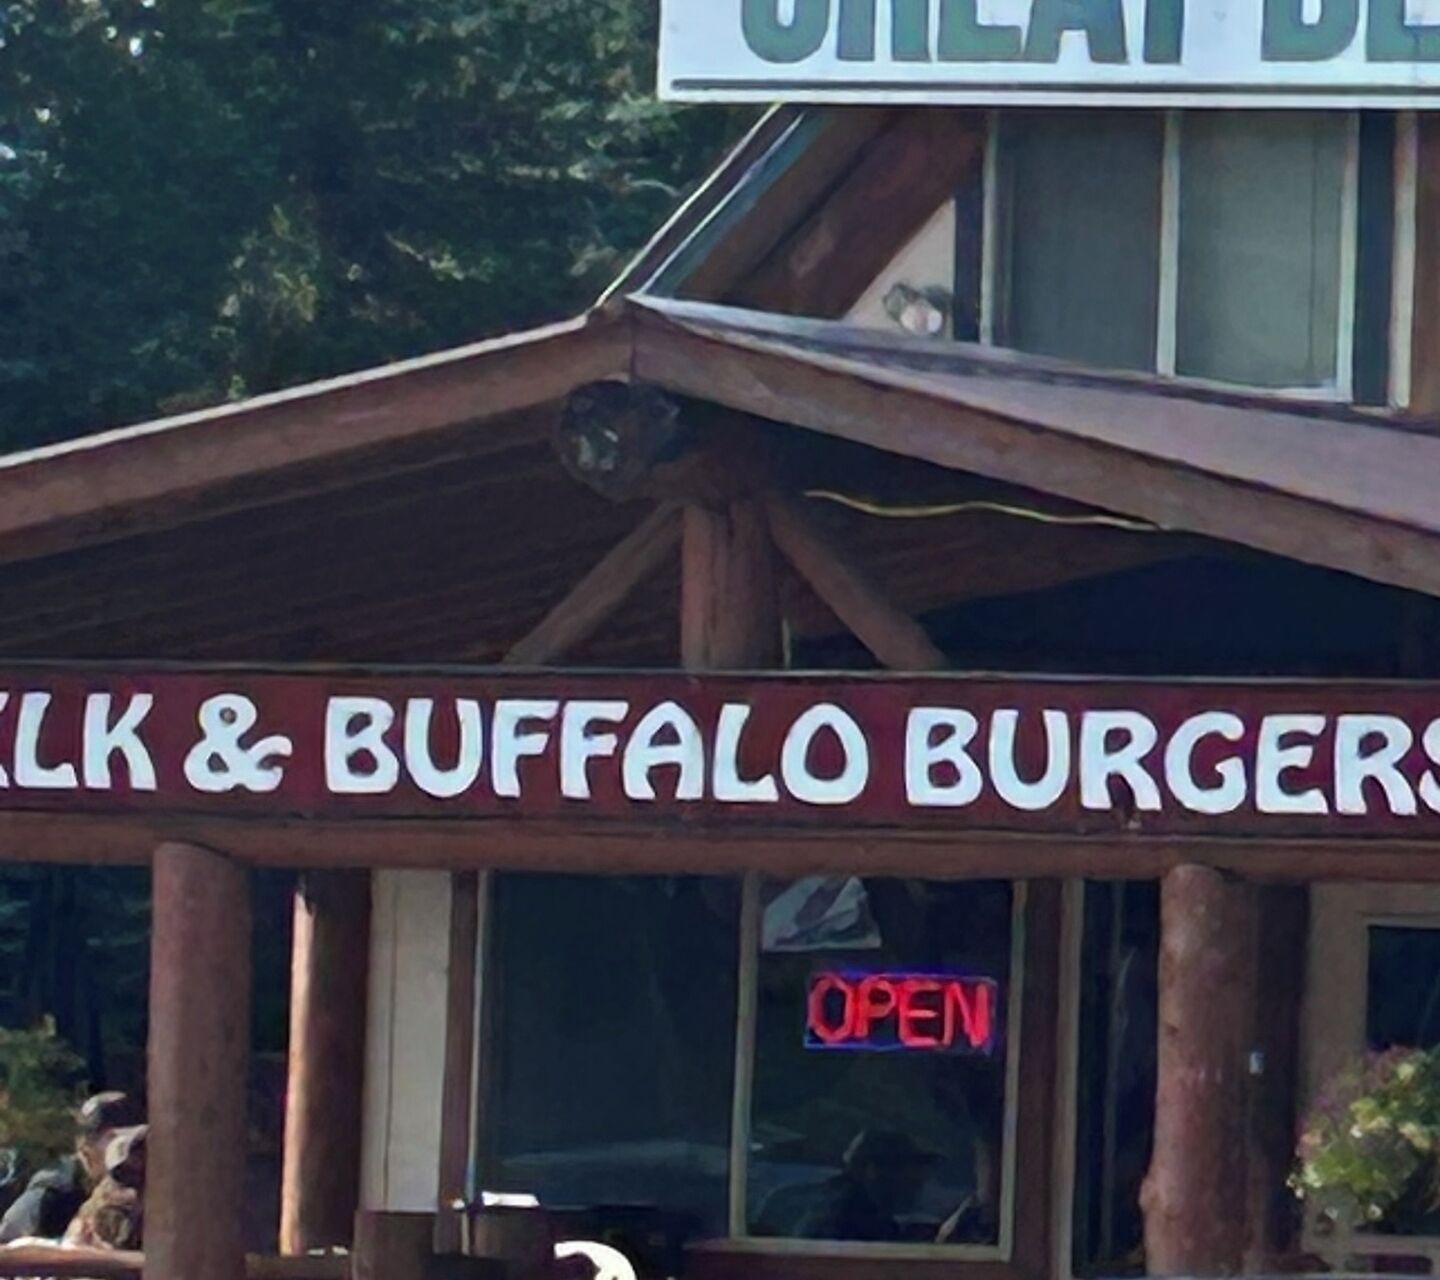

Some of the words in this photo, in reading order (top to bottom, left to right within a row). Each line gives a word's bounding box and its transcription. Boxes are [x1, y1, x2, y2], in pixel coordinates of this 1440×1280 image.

[0, 691, 157, 791] LK
[182, 693, 293, 793] &
[324, 695, 870, 805] BUFFALO
[807, 971, 991, 1048] OPEN
